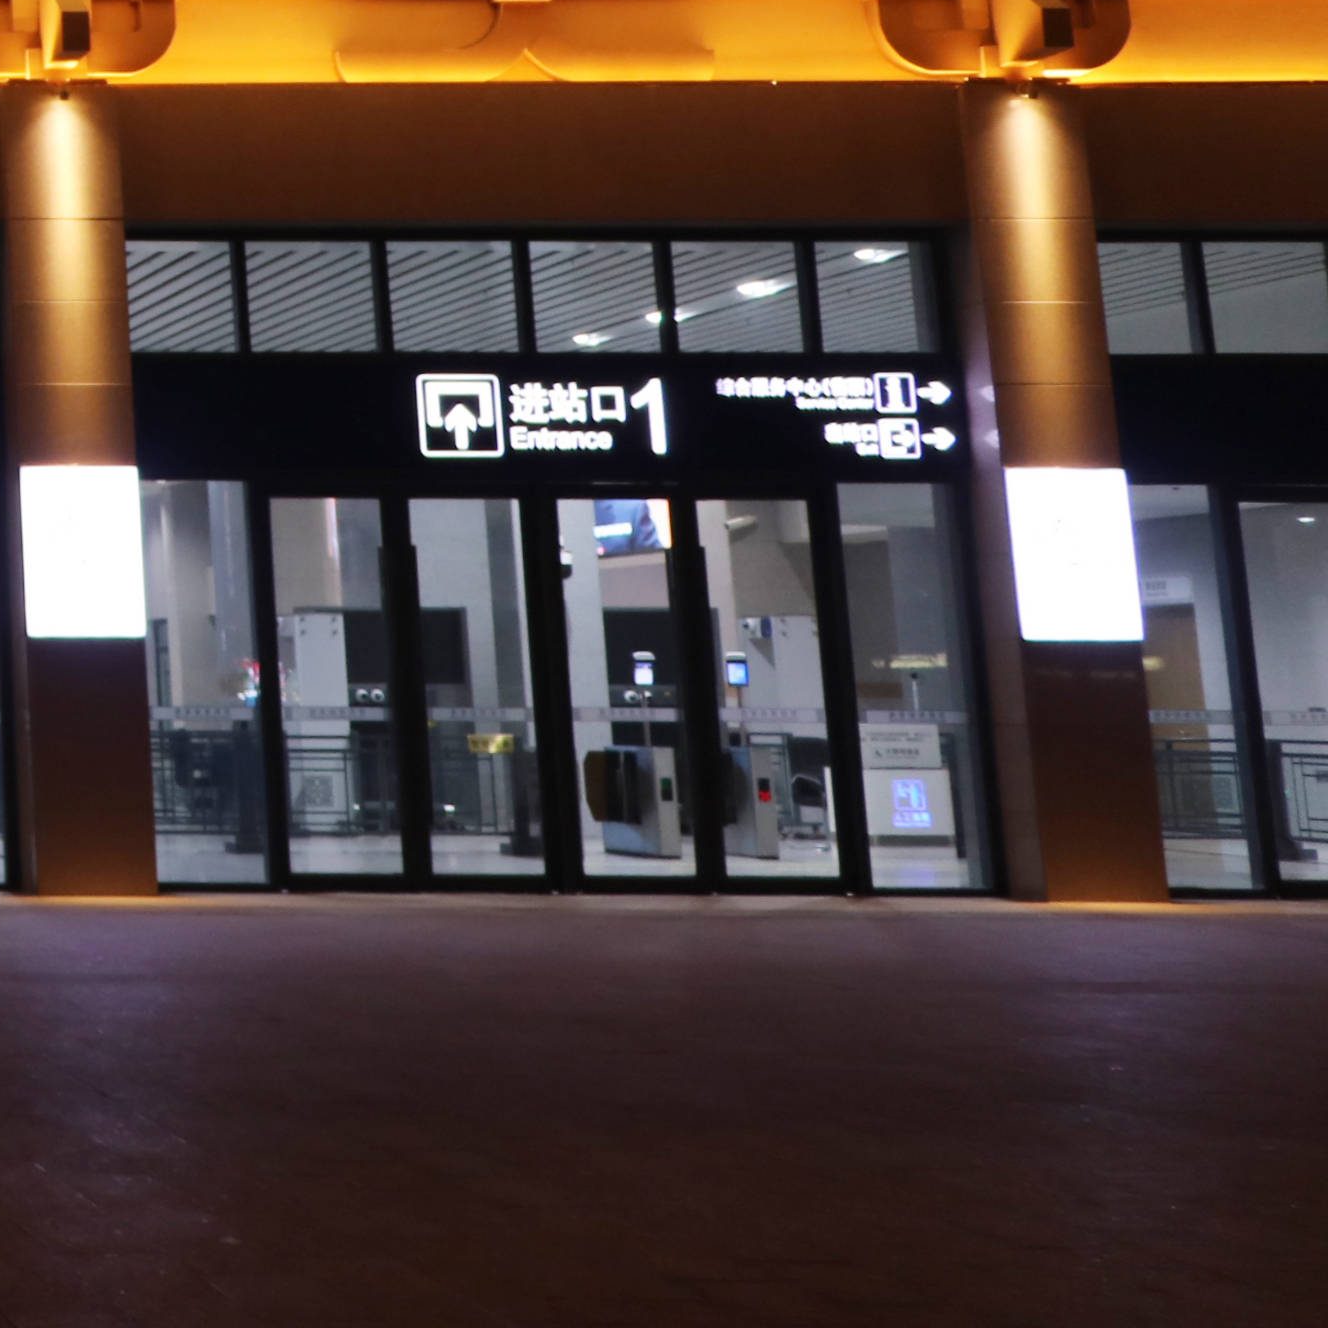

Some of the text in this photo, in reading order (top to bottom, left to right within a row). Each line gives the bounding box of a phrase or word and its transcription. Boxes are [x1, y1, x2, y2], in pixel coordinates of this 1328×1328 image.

[509, 381, 627, 424] 进站口
[509, 425, 614, 451] Entrance
